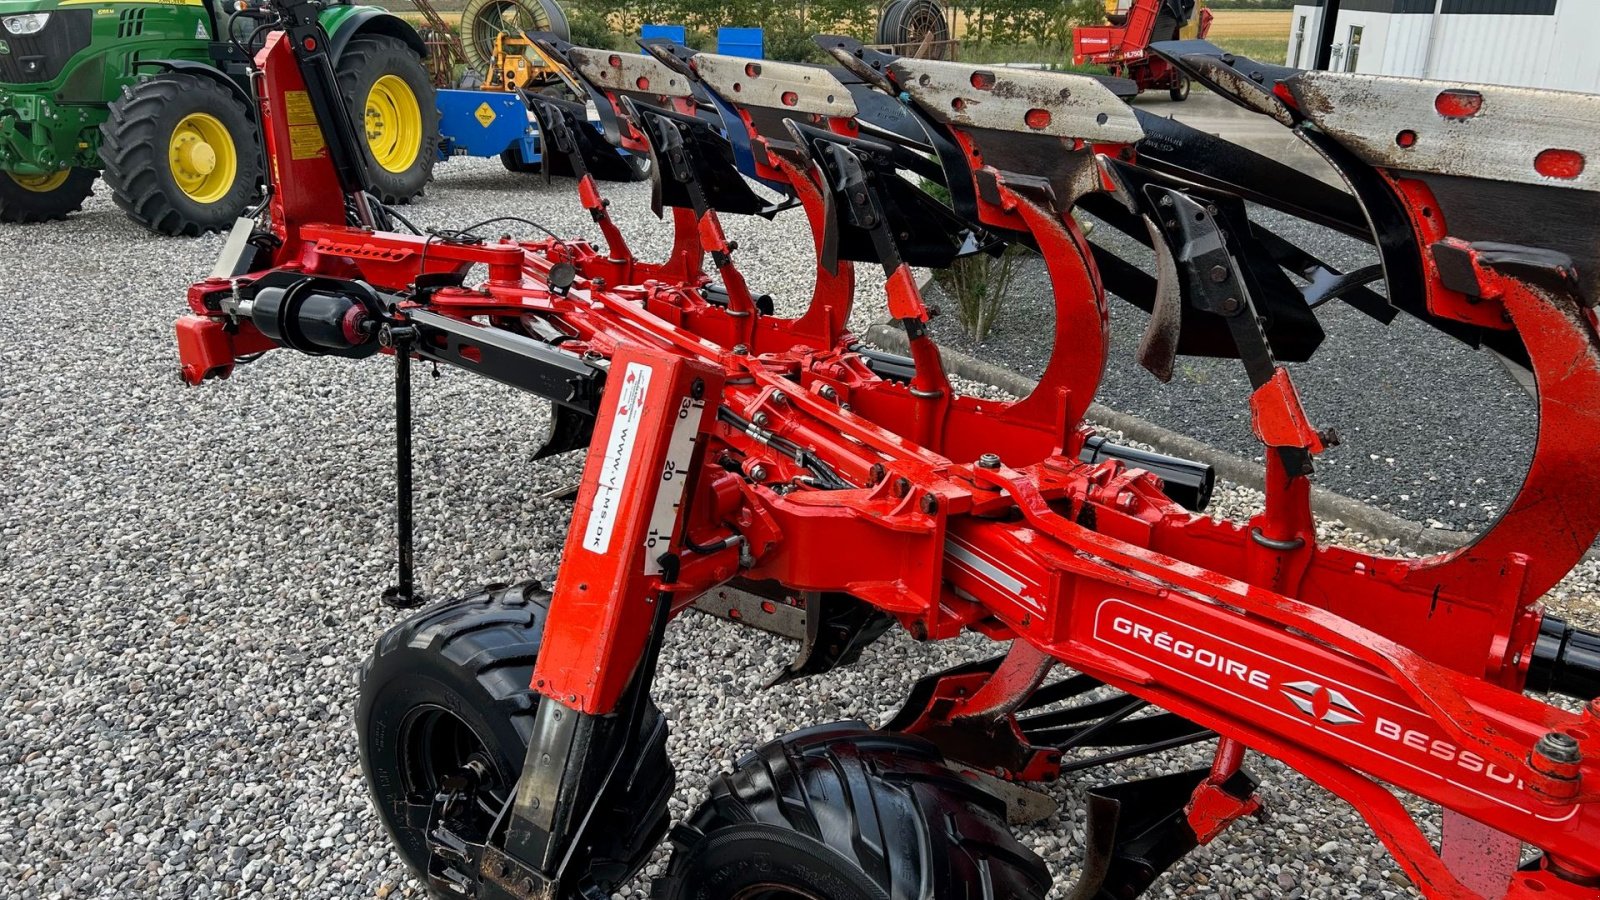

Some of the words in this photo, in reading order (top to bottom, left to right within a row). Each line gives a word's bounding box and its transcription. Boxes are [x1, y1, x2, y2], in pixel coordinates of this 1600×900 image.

[679, 398, 691, 419] 30
[662, 460, 675, 481] 20
[593, 428, 628, 547] WWW.VLMS.DK
[647, 528, 658, 548] 10
[1113, 616, 1271, 690] GRÉGOIRE
[1375, 717, 1525, 791] BESSO
